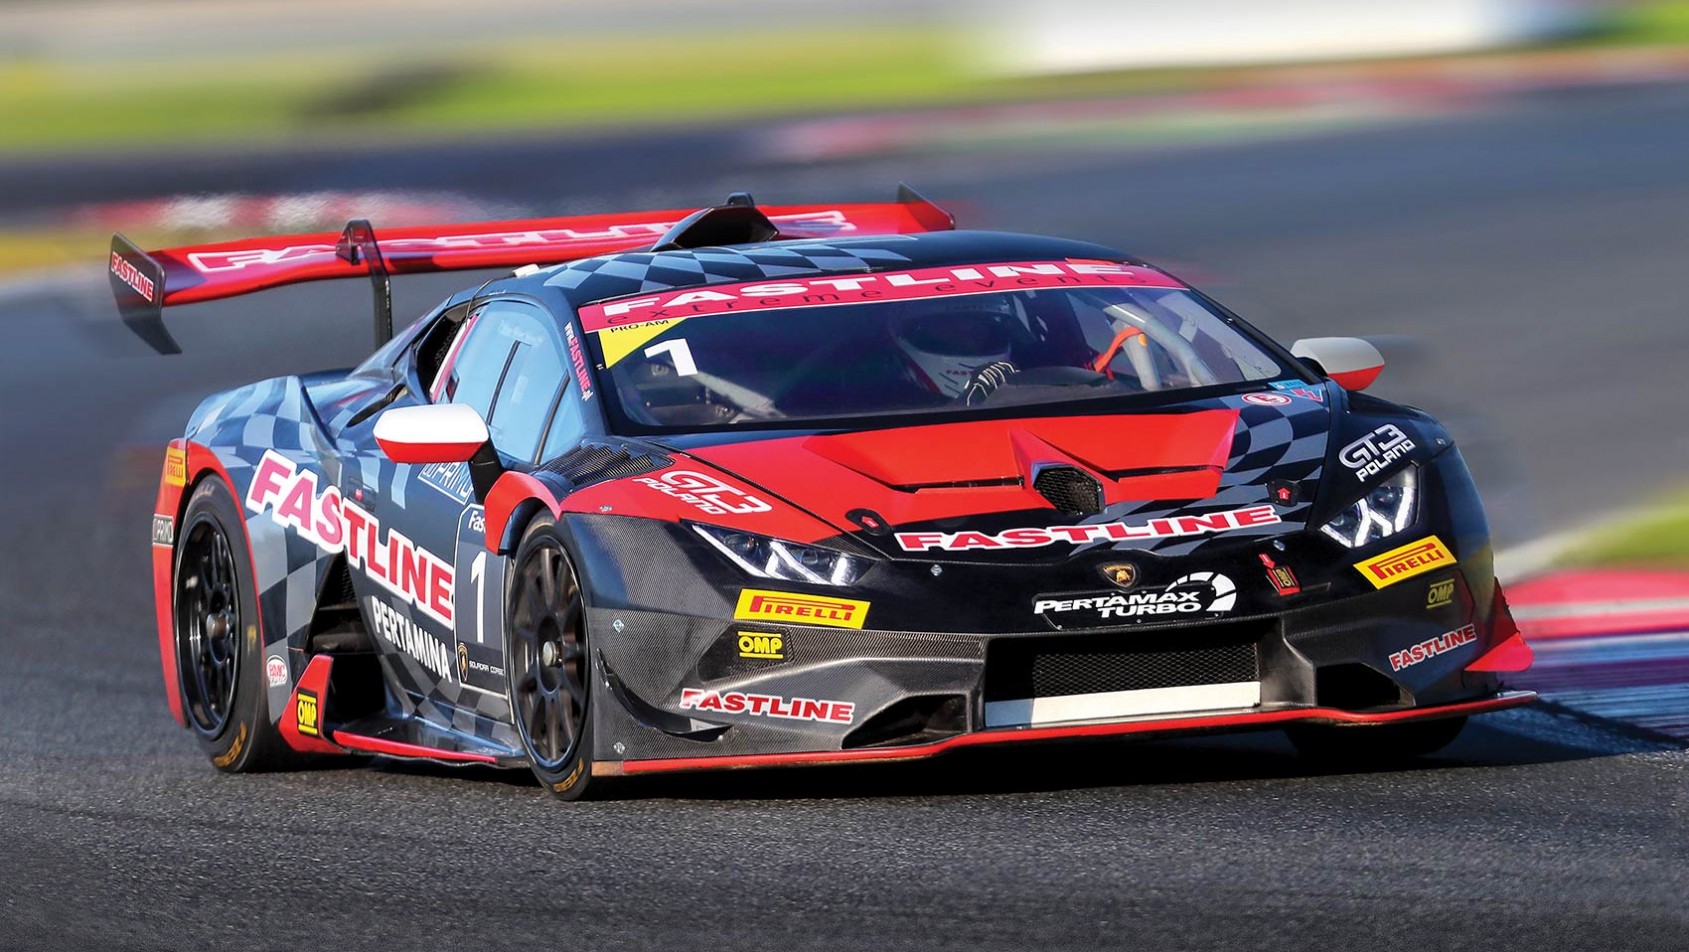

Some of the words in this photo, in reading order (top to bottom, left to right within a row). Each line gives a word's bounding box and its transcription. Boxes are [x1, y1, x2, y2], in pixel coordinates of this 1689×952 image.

[111, 251, 154, 301] FASTLINE
[603, 263, 1134, 316] FASTLINE
[607, 288, 882, 324] extreme
[934, 273, 1148, 292] events
[610, 319, 670, 333] PRO-AM
[643, 338, 699, 376] 1
[1339, 424, 1408, 469] GT3
[1355, 439, 1416, 483] POLAND
[631, 477, 728, 515] POLAND
[661, 470, 773, 514] GT3
[247, 451, 455, 628] FASTLINE
[894, 505, 1281, 551] FASTLINE
[1368, 542, 1445, 580] PIRELLI
[470, 550, 487, 643] 1
[749, 595, 857, 621] PIRELLI
[1034, 591, 1201, 614] PERTAMAX
[1098, 602, 1202, 618] TURBO
[1427, 581, 1455, 606] OMP
[371, 595, 453, 684] PERTAMINA
[738, 633, 784, 657] OMP
[1389, 623, 1477, 672] FASTLINE
[298, 697, 317, 730] OMP
[680, 688, 856, 725] FASTLINE
